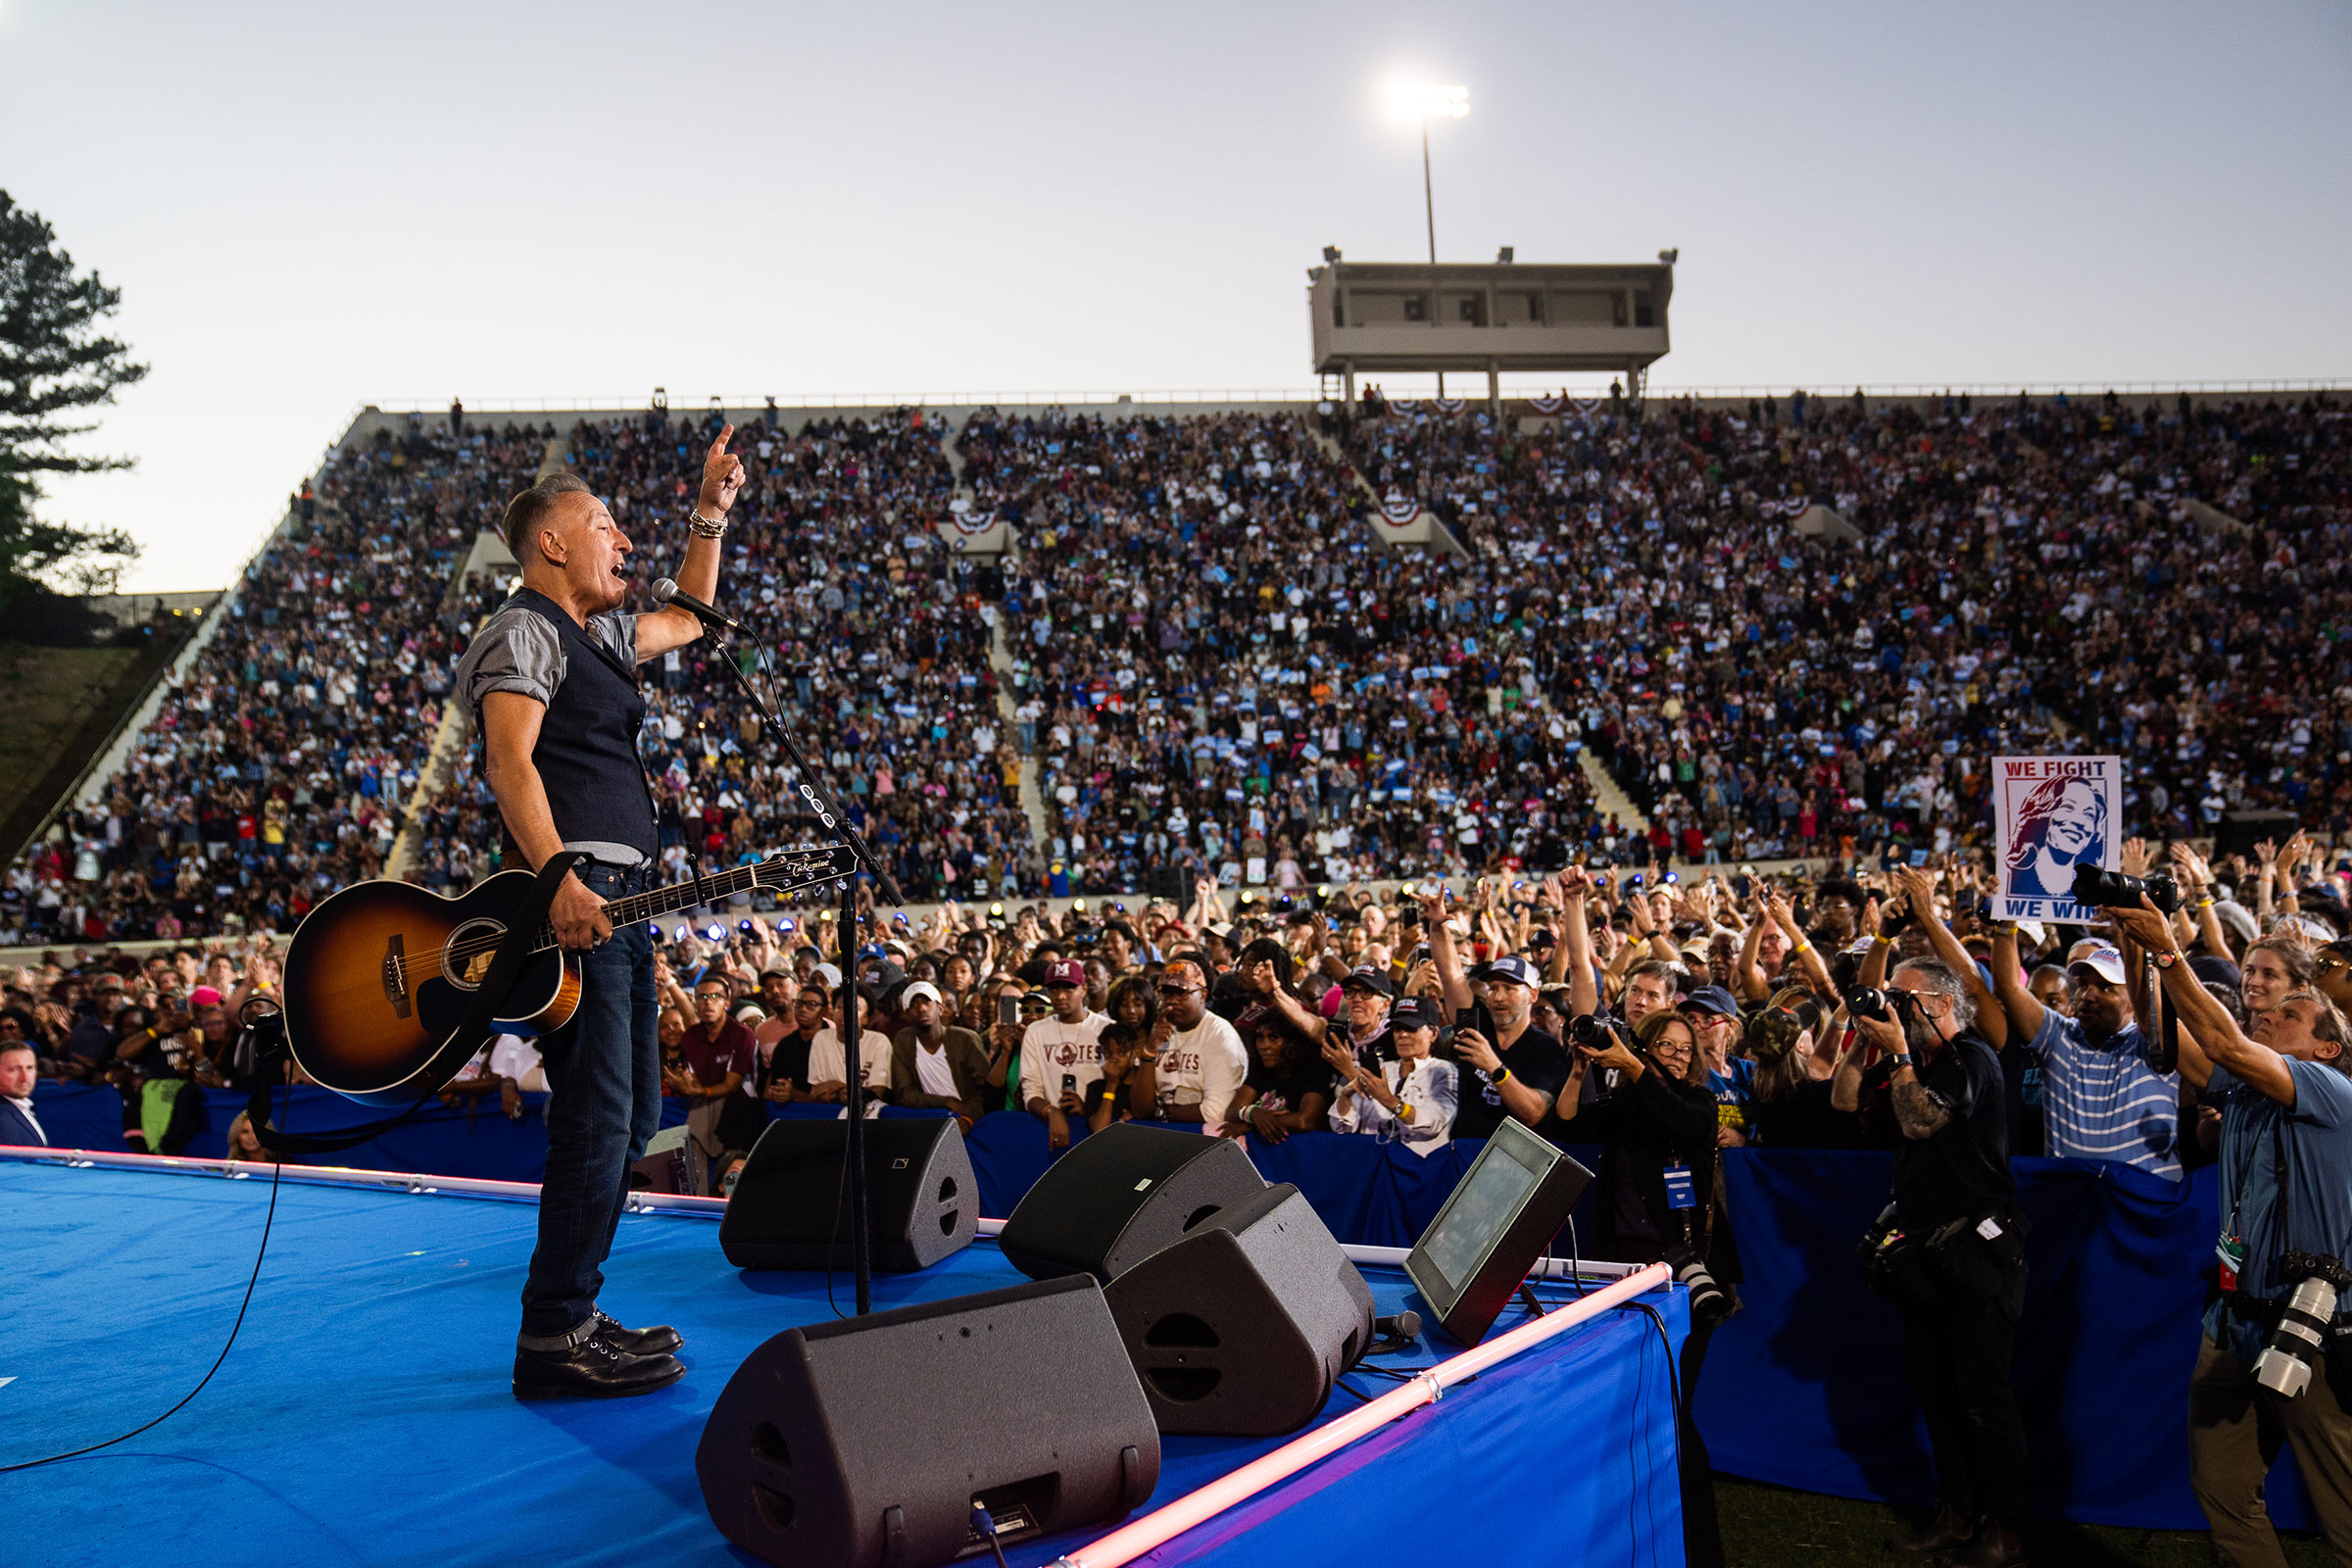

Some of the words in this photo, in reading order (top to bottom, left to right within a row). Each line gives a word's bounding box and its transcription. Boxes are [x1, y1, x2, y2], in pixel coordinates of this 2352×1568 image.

[2004, 761, 2036, 776] WE
[2044, 761, 2106, 776] FIGHT
[2006, 900, 2041, 917] WE
[1054, 962, 1070, 977] M
